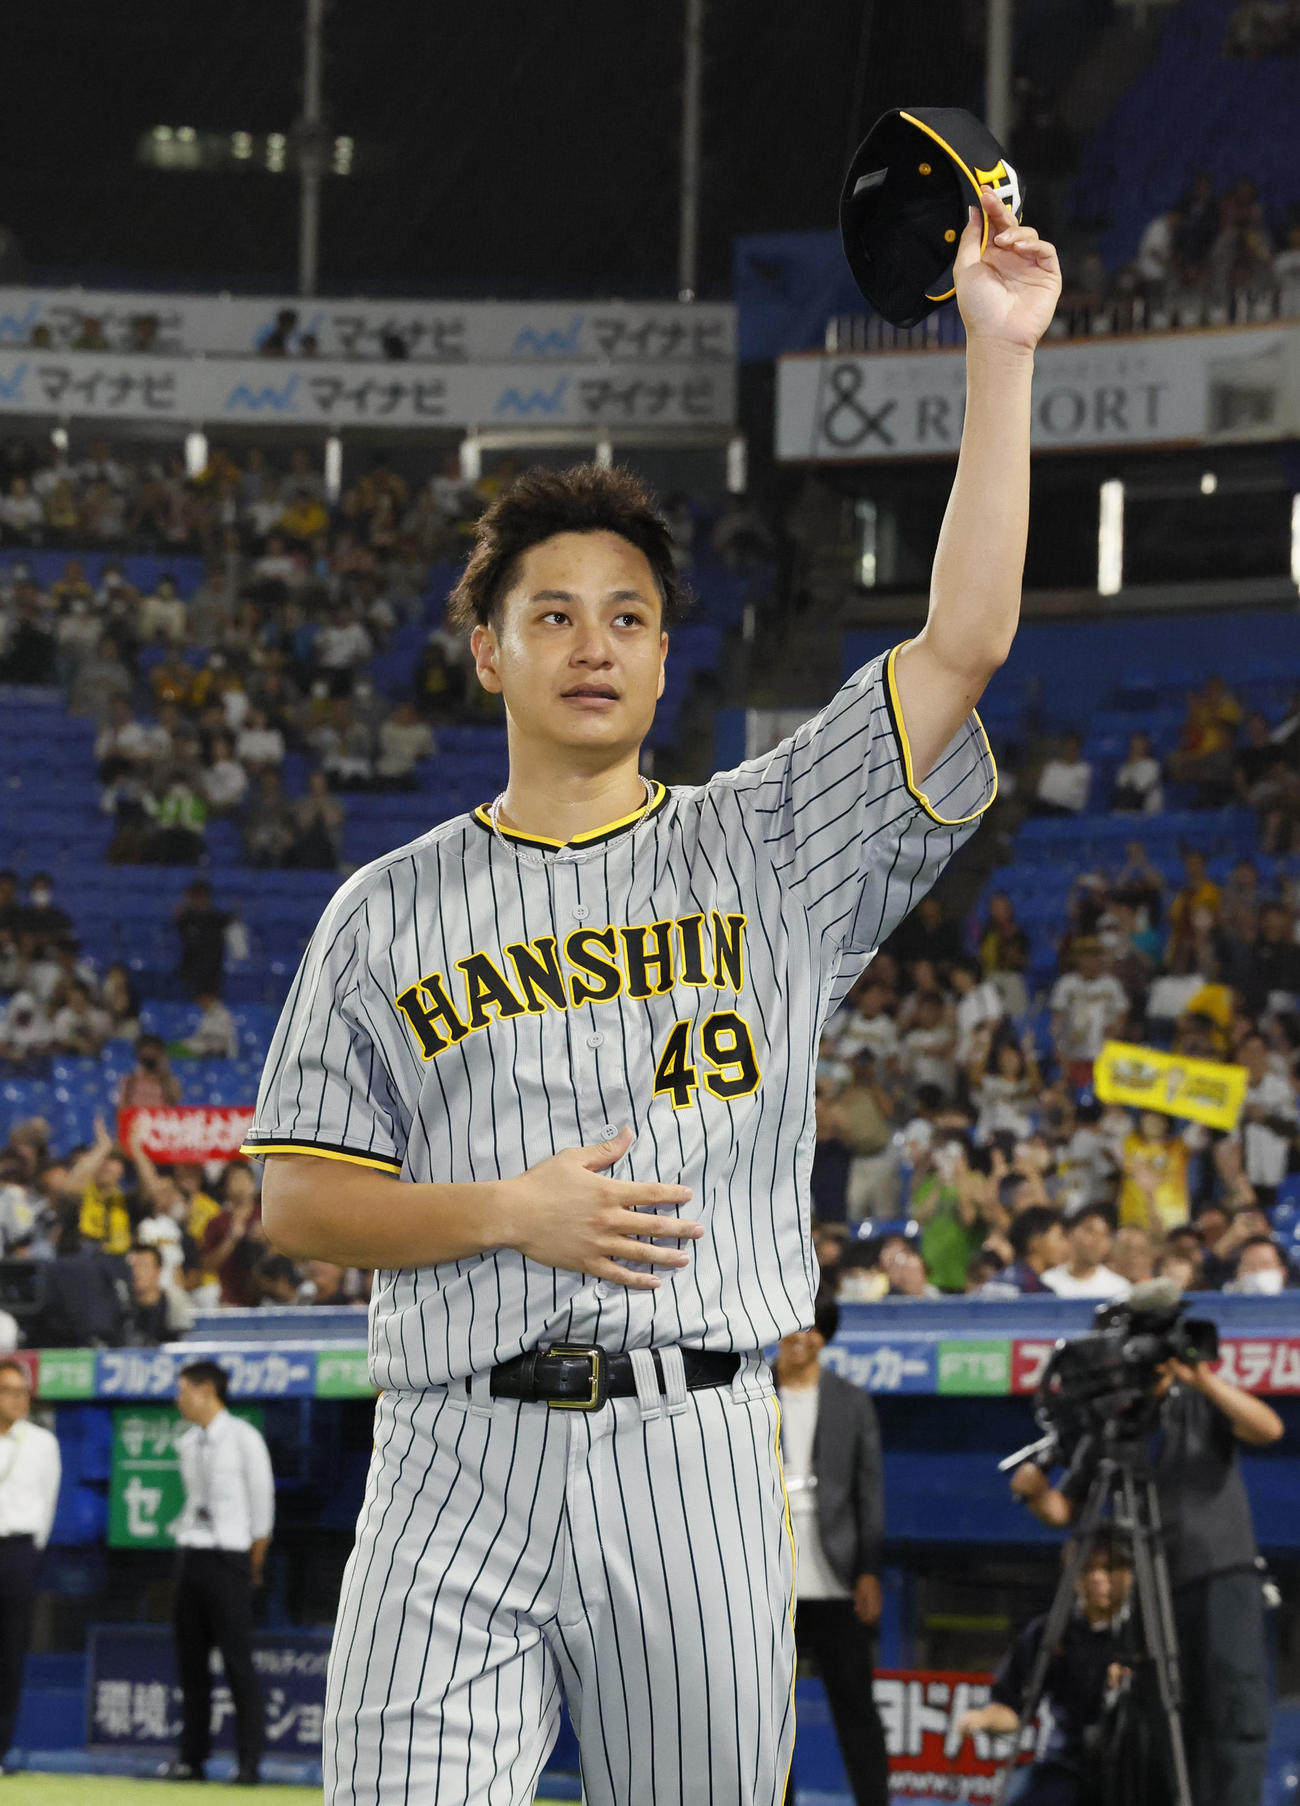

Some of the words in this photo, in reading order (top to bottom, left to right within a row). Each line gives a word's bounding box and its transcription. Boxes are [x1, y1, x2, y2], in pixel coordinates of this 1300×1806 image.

[593, 316, 728, 357] マイナビ
[36, 365, 176, 410] マイナビ
[306, 375, 446, 416] マイナビ
[578, 378, 716, 417] マイナビ
[915, 381, 1168, 442] RORT
[395, 909, 748, 1062] HANSHIN
[652, 1009, 762, 1111] 49
